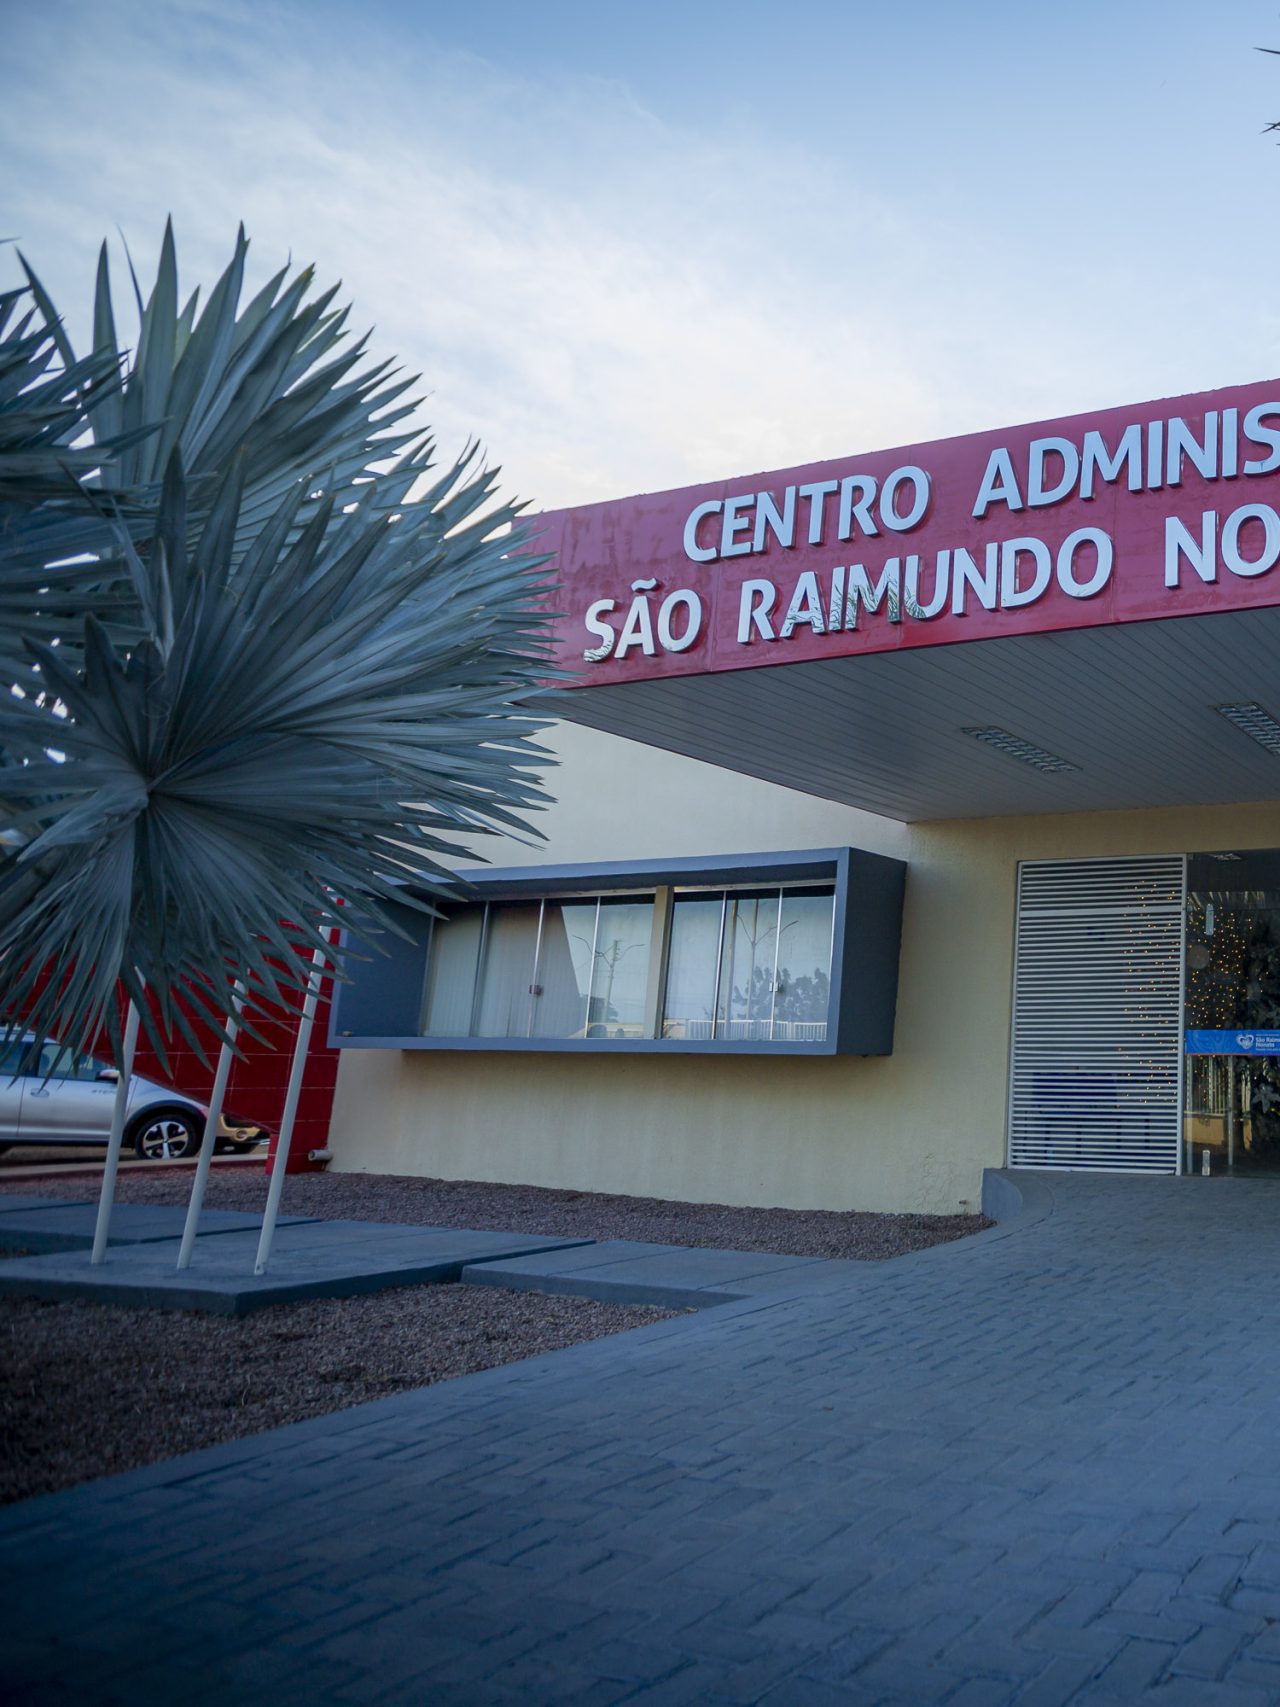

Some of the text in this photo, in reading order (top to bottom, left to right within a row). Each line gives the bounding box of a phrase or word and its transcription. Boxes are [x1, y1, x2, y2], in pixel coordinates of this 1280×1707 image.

[683, 465, 931, 563] CENTRO
[583, 577, 702, 663] SÃO
[736, 527, 1114, 644] RAIMUNDO
